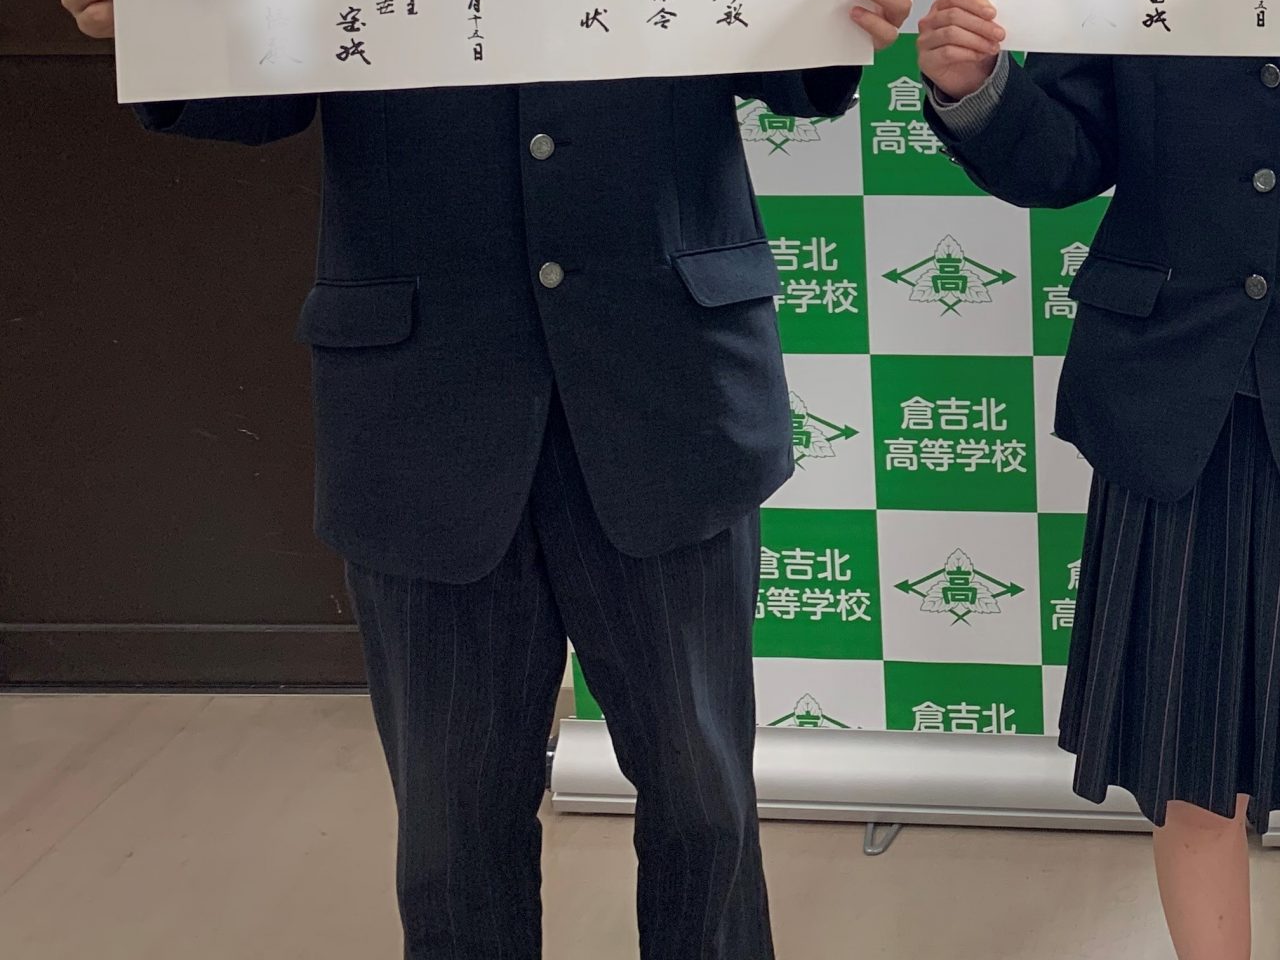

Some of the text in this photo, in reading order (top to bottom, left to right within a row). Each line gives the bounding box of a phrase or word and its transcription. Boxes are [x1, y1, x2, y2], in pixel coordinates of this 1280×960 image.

[886, 74, 923, 112] 倉
[869, 118, 946, 156] 高等
[767, 235, 838, 272] 吉北
[774, 279, 860, 314] 学校
[900, 395, 1009, 432] 倉吉北
[884, 437, 1026, 474] 高等学校
[759, 545, 852, 582] 倉吉北
[911, 700, 1018, 734] 倉吉北
